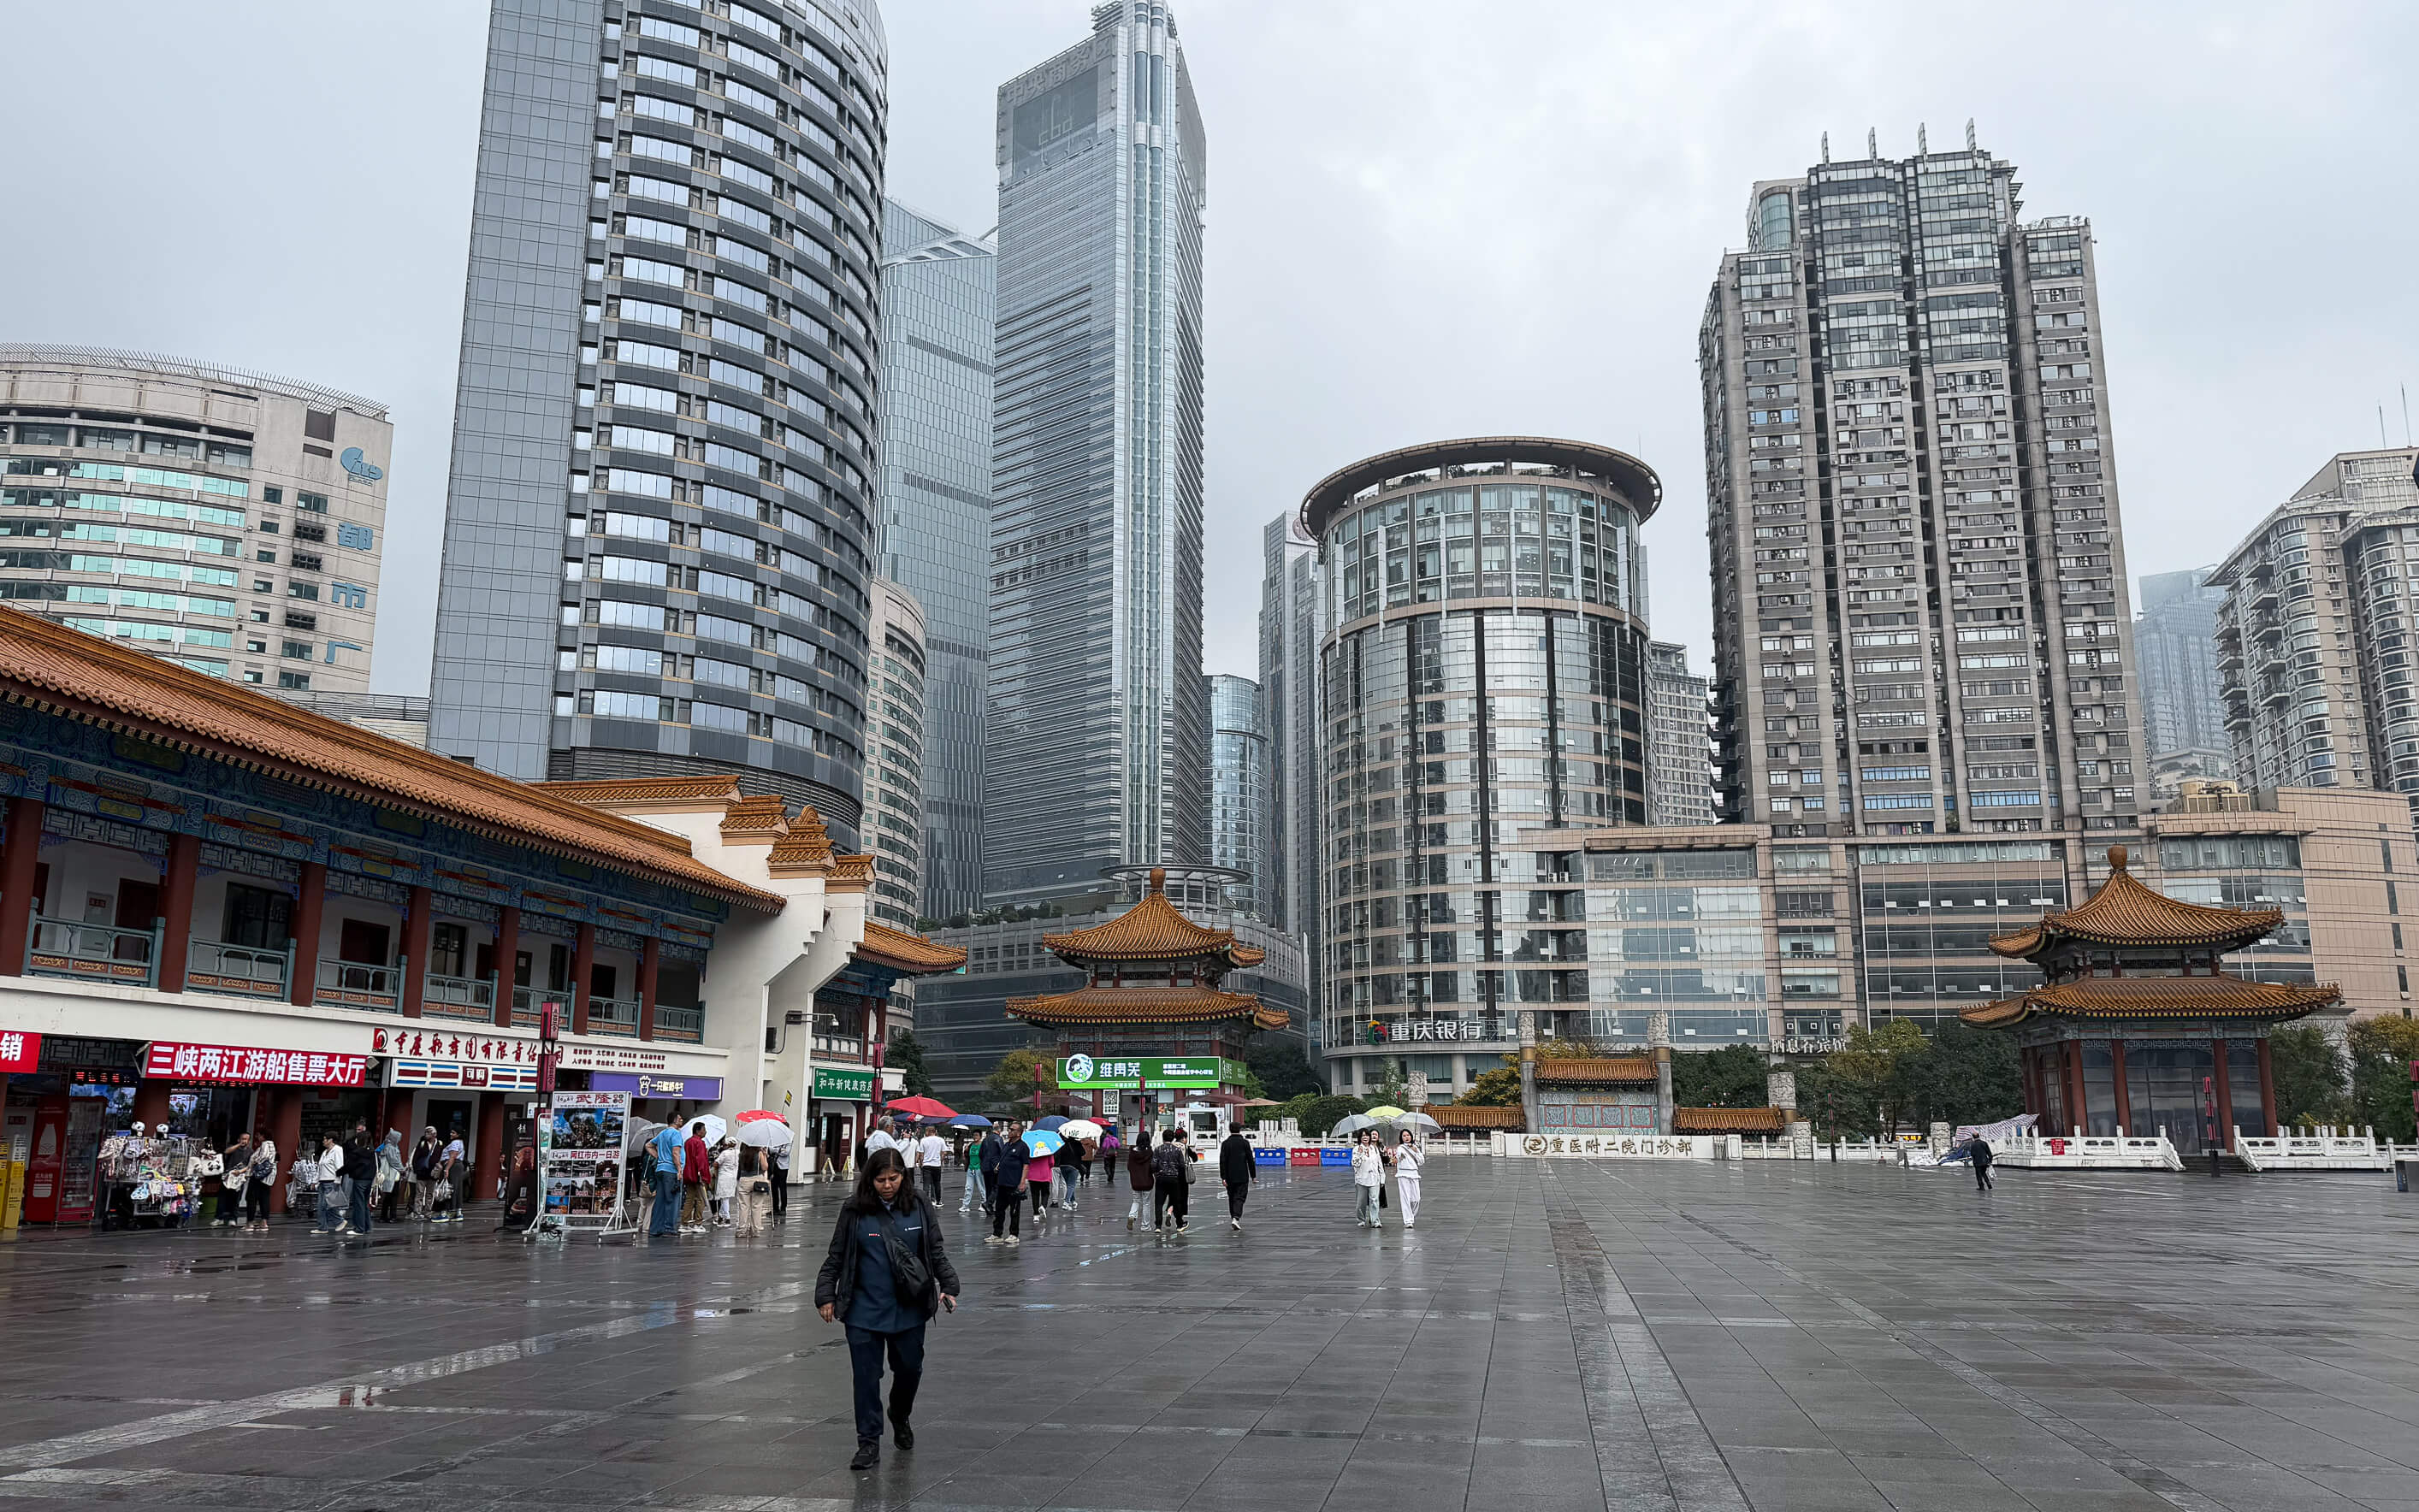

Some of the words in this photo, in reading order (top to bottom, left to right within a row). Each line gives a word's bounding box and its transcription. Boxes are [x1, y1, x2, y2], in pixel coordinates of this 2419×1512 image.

[1391, 1020, 1483, 1042] 重庆银行
[0, 1032, 24, 1061] 销
[148, 1045, 367, 1084] 三峡两江游船售票大厅
[576, 1094, 612, 1104] 武隆
[571, 1150, 619, 1160] 网红市内一日游
[1550, 1138, 1692, 1157] 重医附二院门诊部
